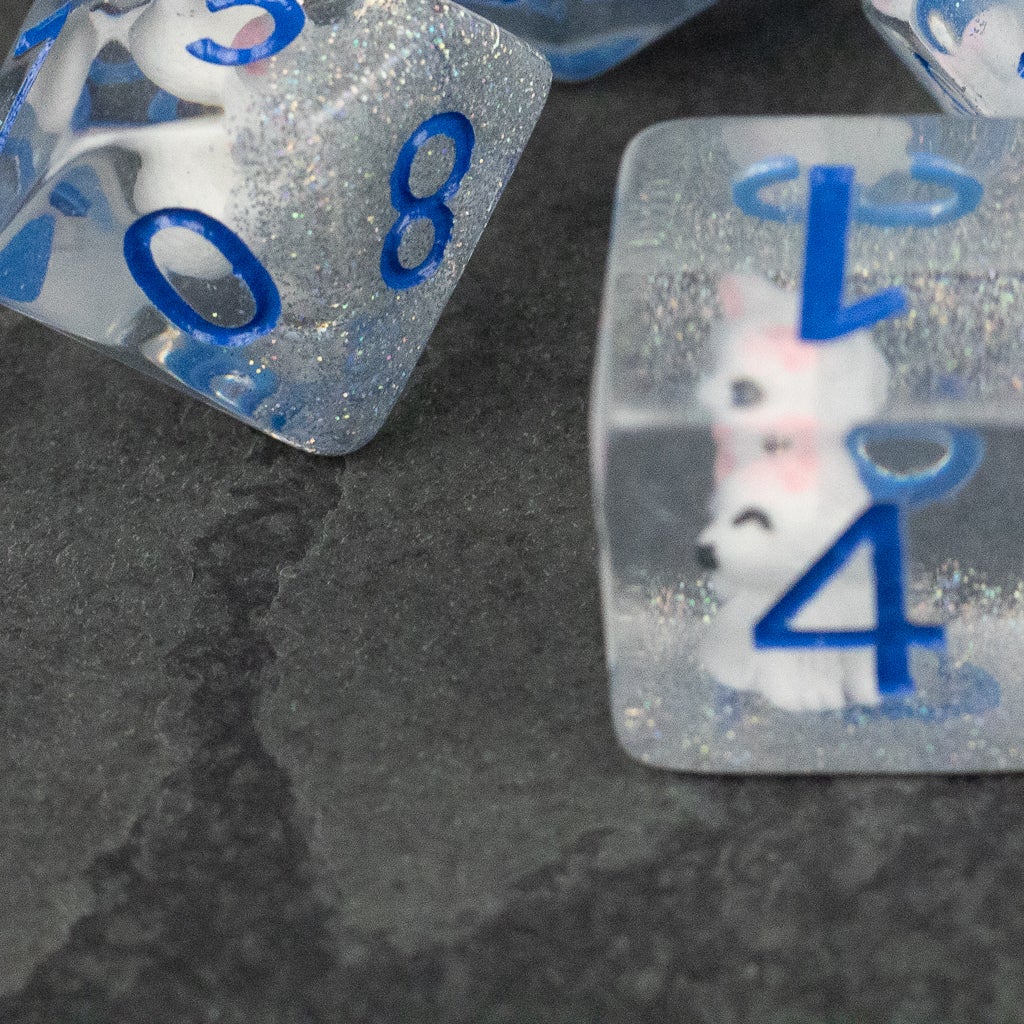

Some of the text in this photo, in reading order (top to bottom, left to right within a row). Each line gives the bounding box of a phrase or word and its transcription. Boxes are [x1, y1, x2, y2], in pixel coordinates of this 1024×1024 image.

[123, 207, 282, 347] 0
[380, 111, 475, 291] 8
[798, 165, 907, 341] 1
[752, 502, 946, 695] 4
